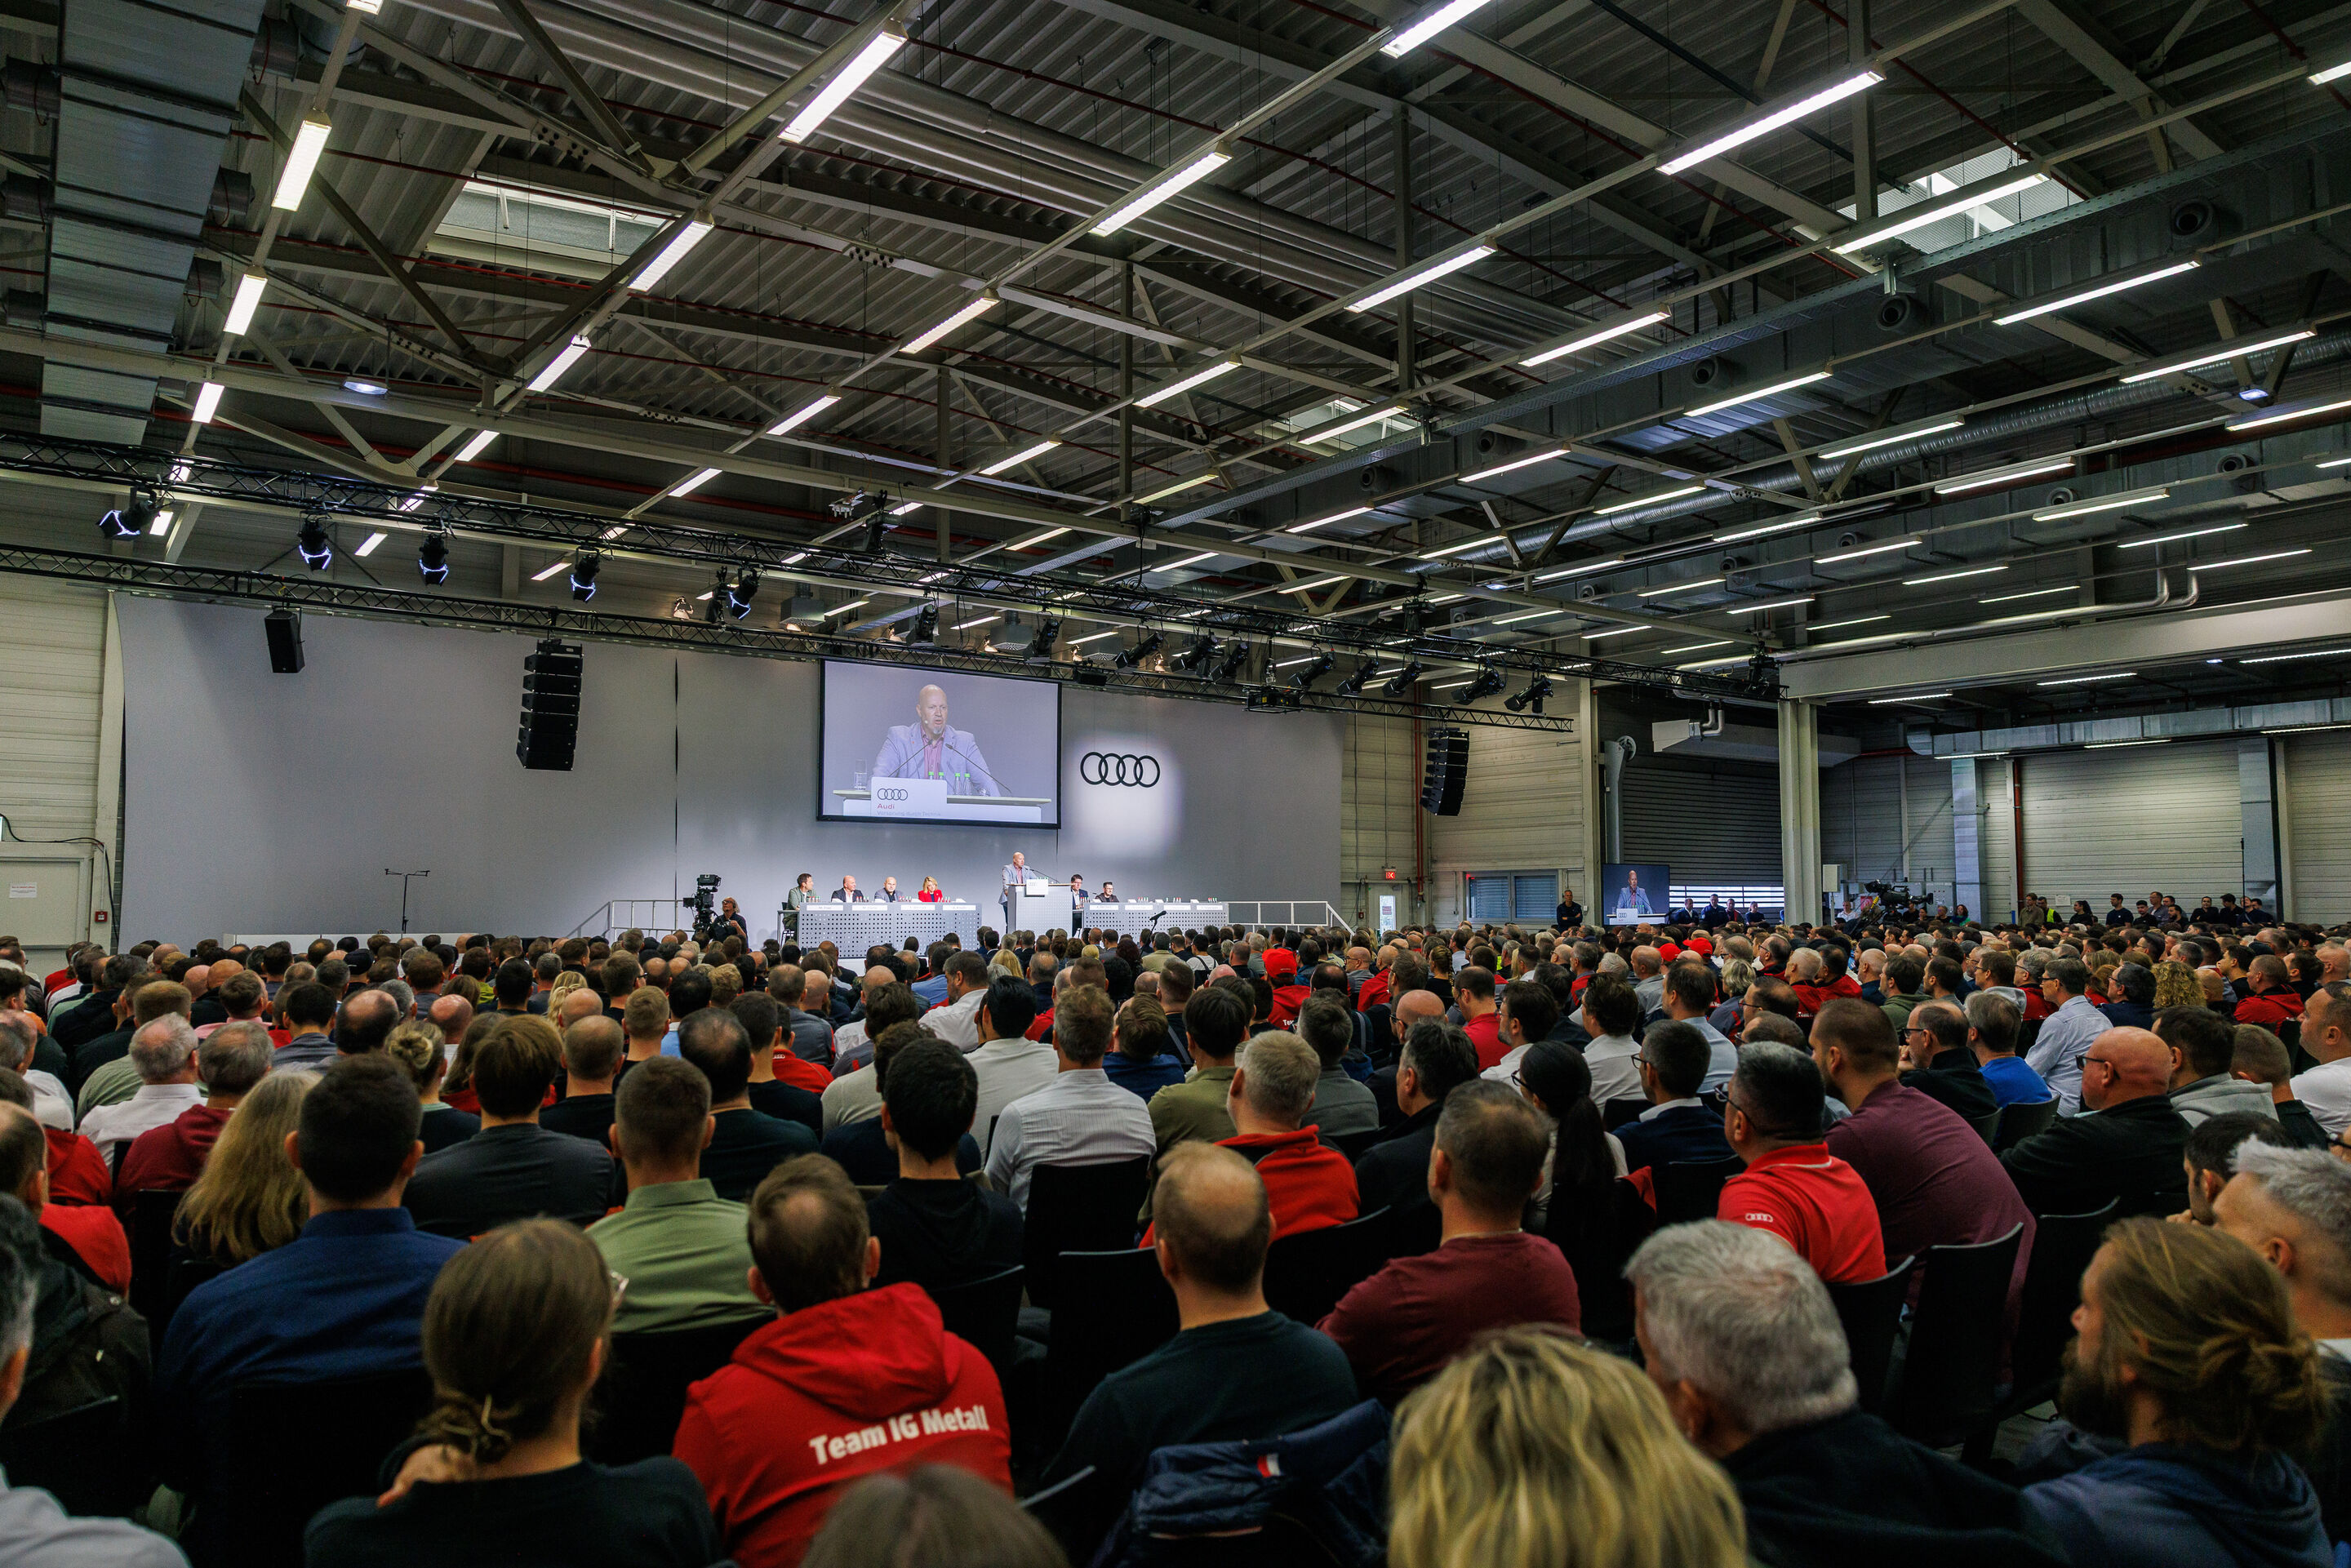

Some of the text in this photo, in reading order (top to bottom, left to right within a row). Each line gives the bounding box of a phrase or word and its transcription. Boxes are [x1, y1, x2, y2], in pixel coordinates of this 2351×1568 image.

[809, 1405, 989, 1465] Team IG Metall
